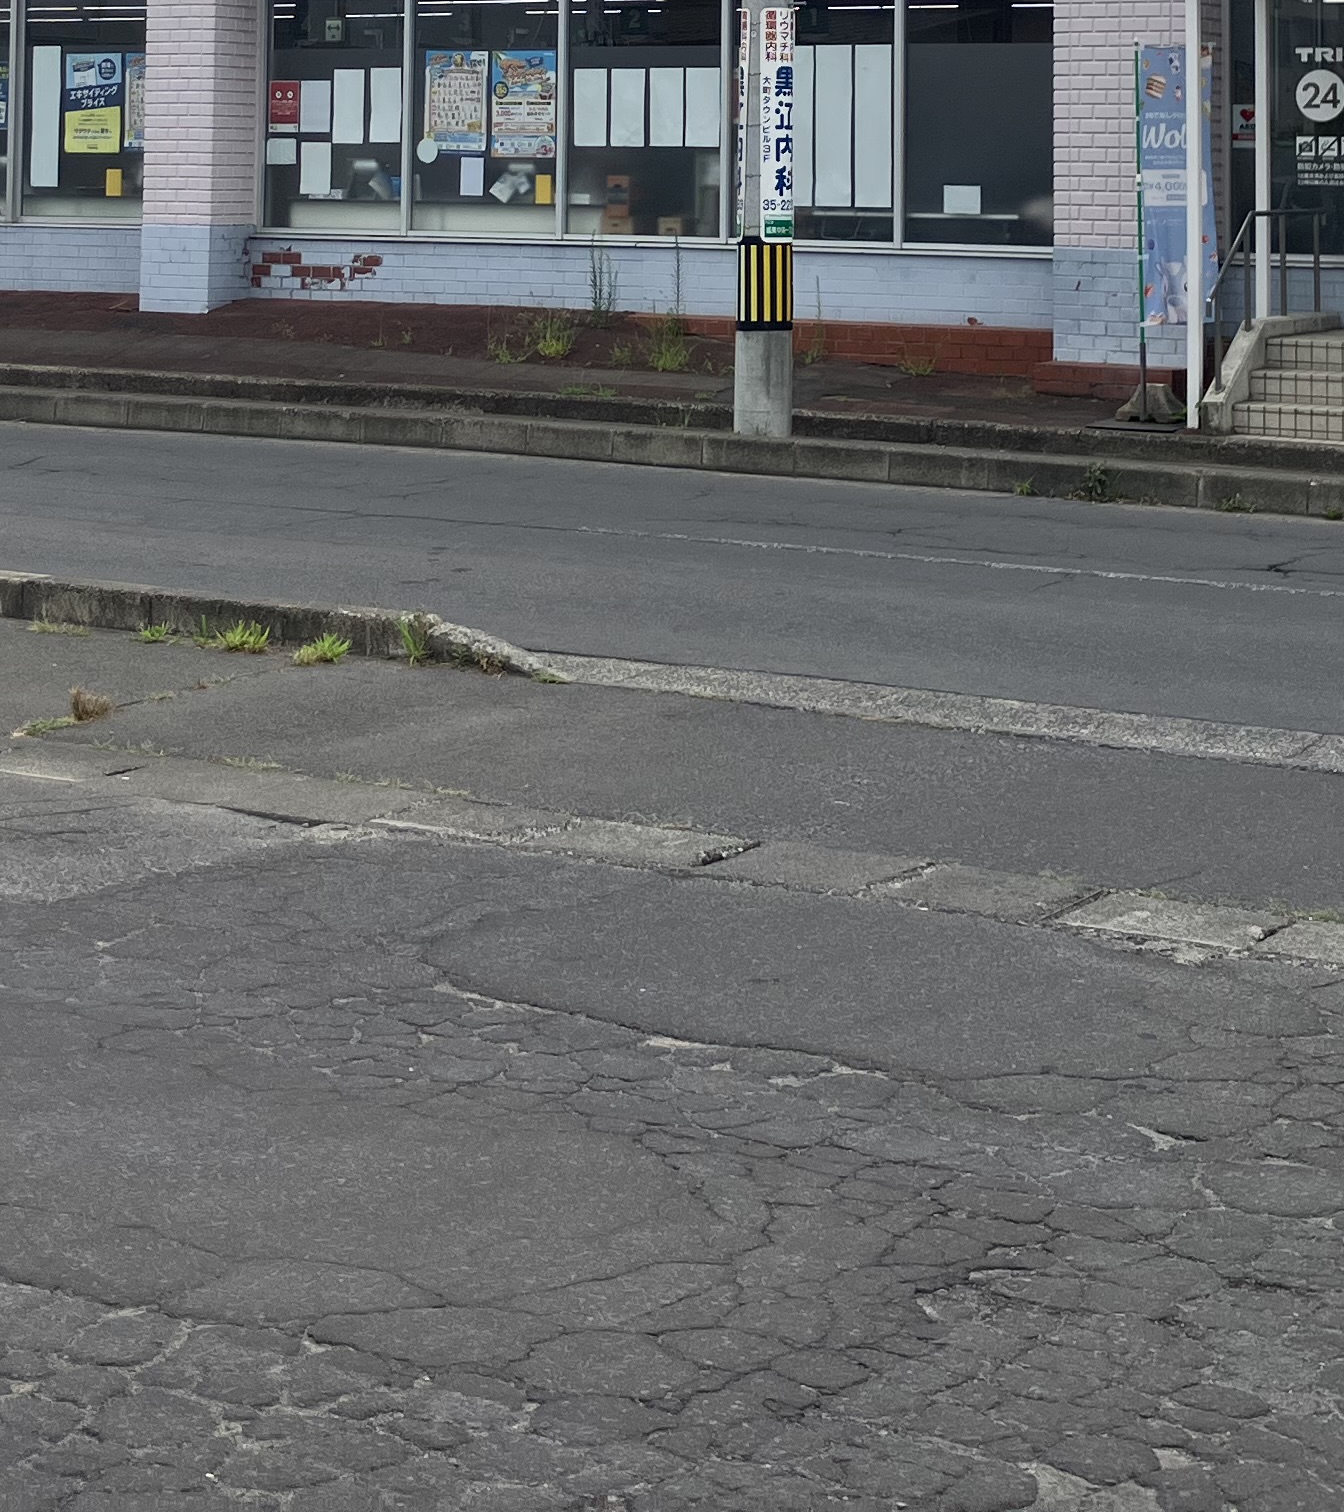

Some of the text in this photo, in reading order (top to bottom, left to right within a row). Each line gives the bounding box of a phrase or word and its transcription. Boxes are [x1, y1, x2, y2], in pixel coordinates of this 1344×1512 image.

[779, 10, 789, 63] リウマチ科
[69, 84, 119, 100] エキサイティング
[80, 97, 106, 108] プライス
[1302, 82, 1341, 109] 24
[1142, 122, 1187, 149] Wol
